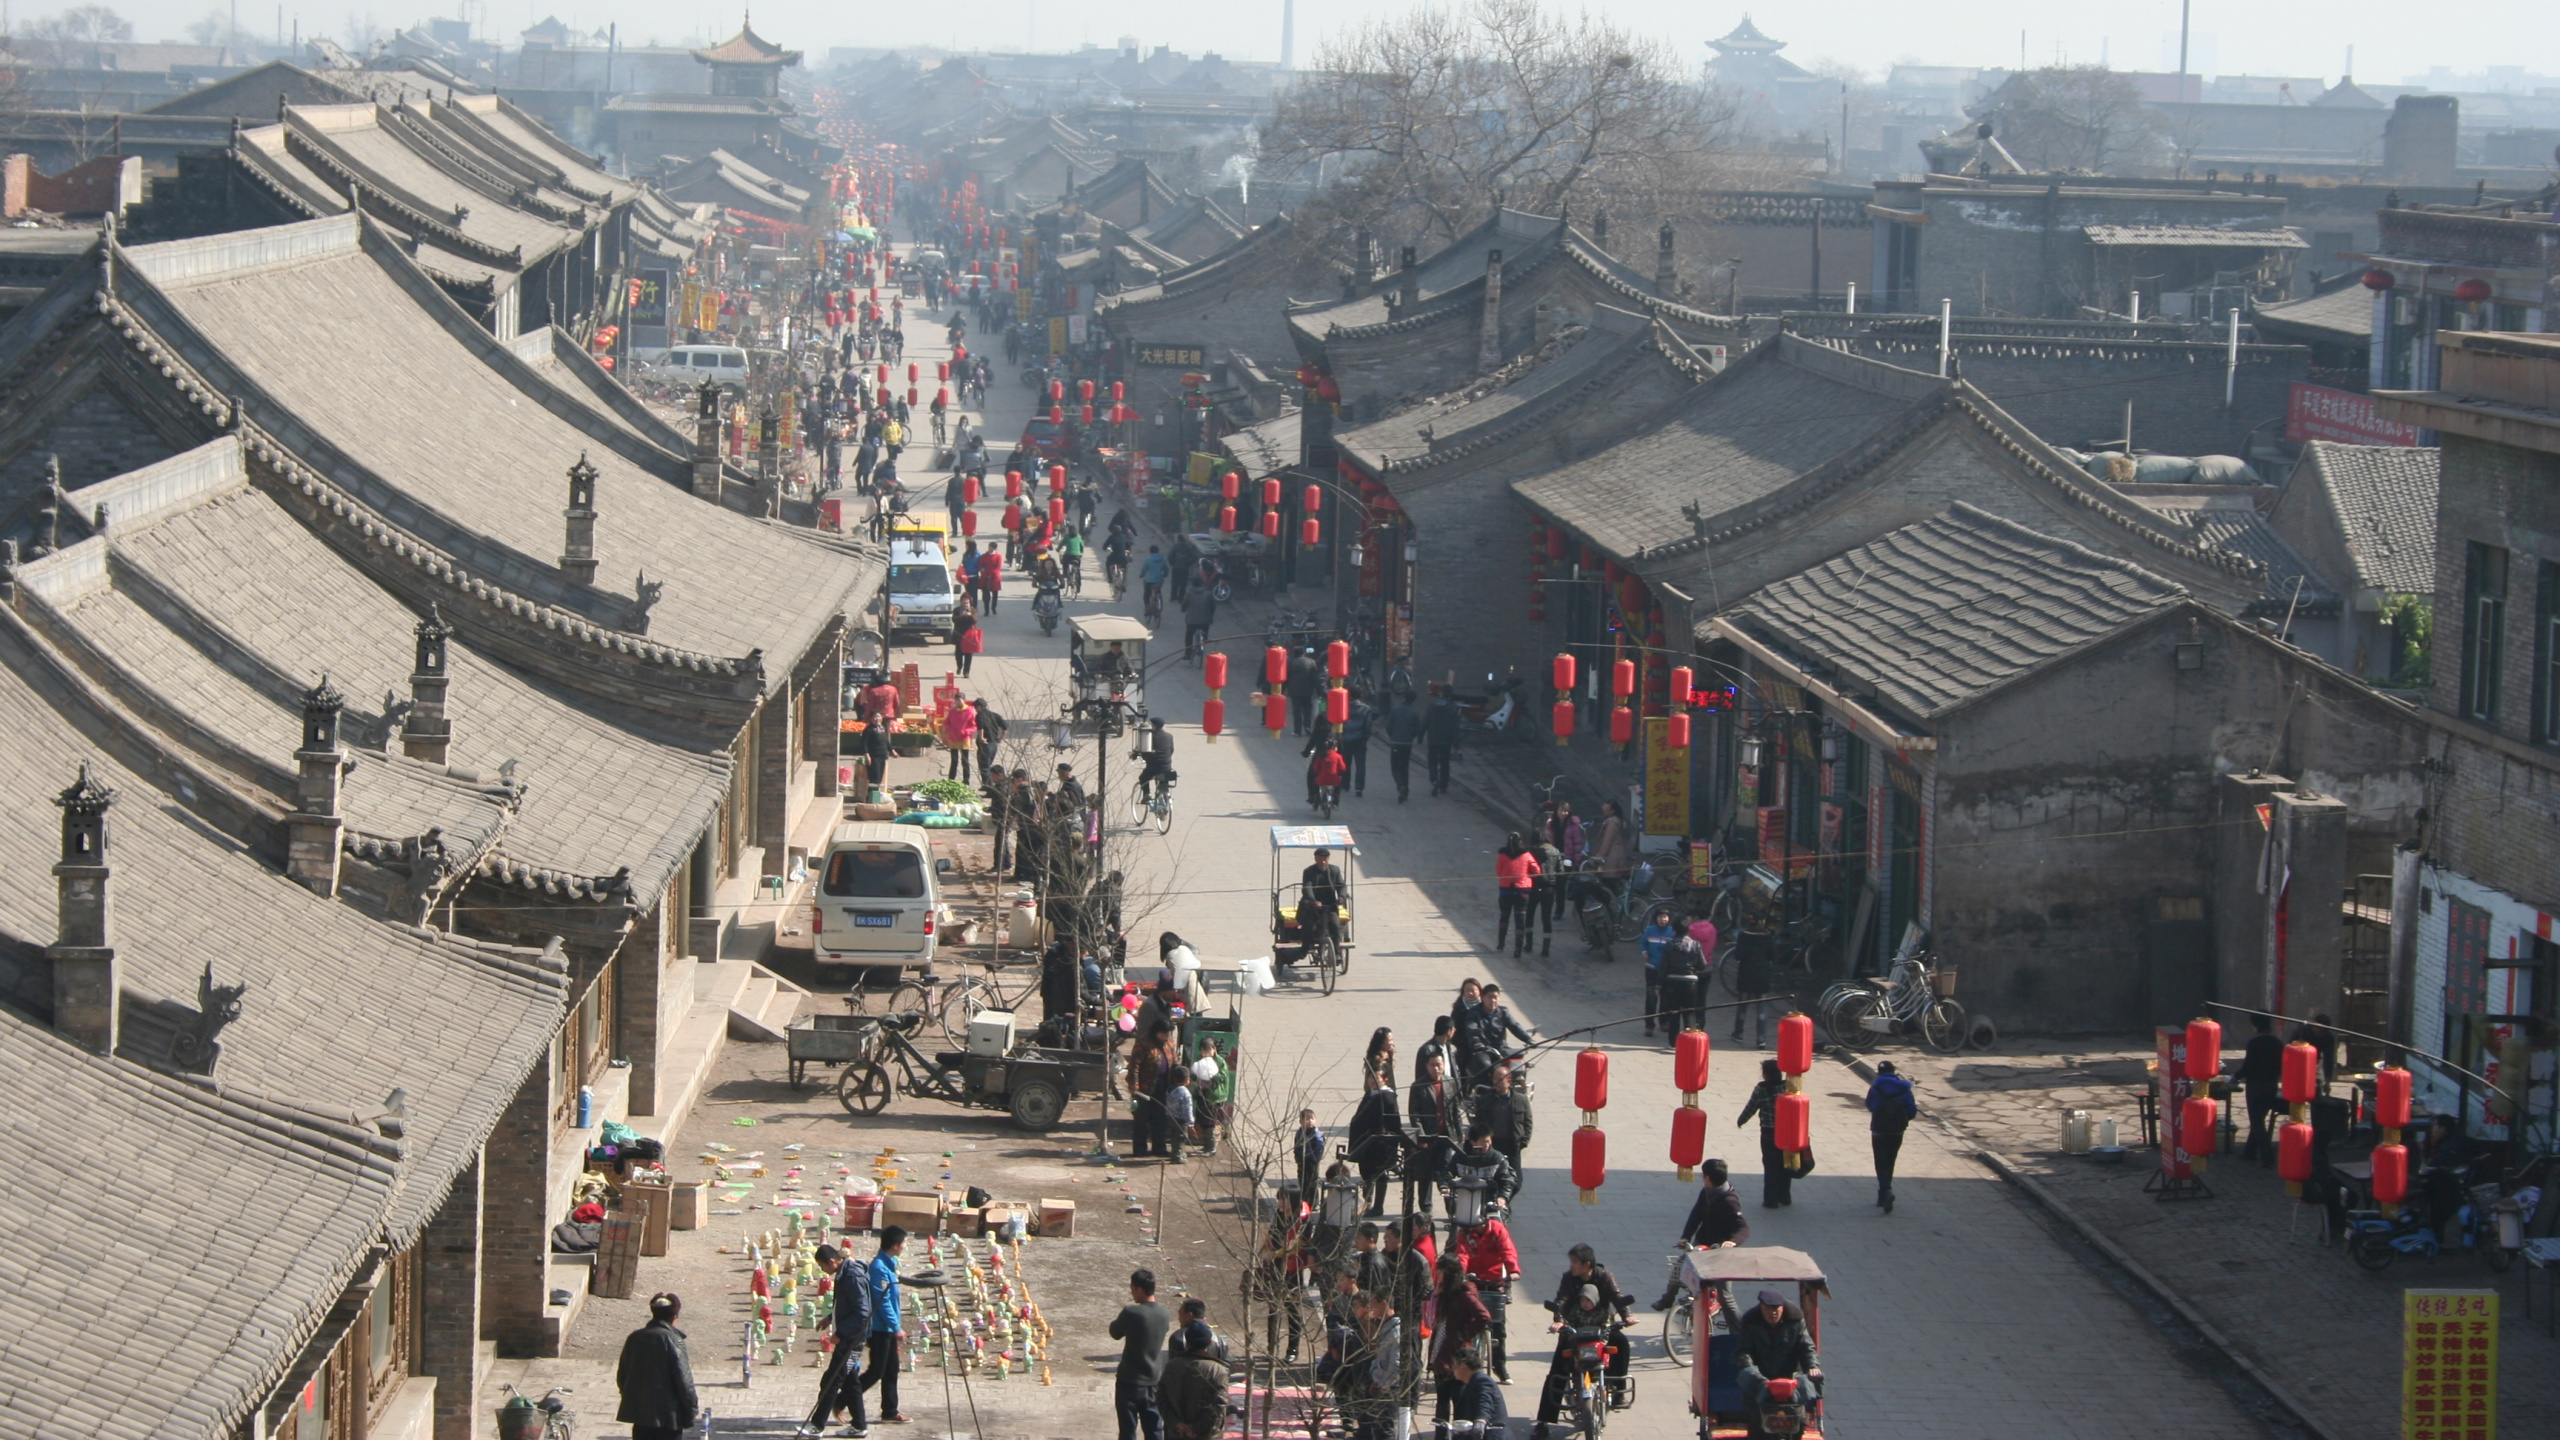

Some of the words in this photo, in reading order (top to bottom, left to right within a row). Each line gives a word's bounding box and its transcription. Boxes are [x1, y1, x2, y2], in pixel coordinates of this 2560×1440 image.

[1140, 348, 1201, 365] 大光明配镜
[2416, 1296, 2490, 1317] 传统名吃
[2416, 1353, 2488, 1366] 炒饼丝
[2415, 1368, 2488, 1381] 盖浇饭
[2415, 1383, 2487, 1396] 水煎包
[2414, 1414, 2487, 1427] 刀削面
